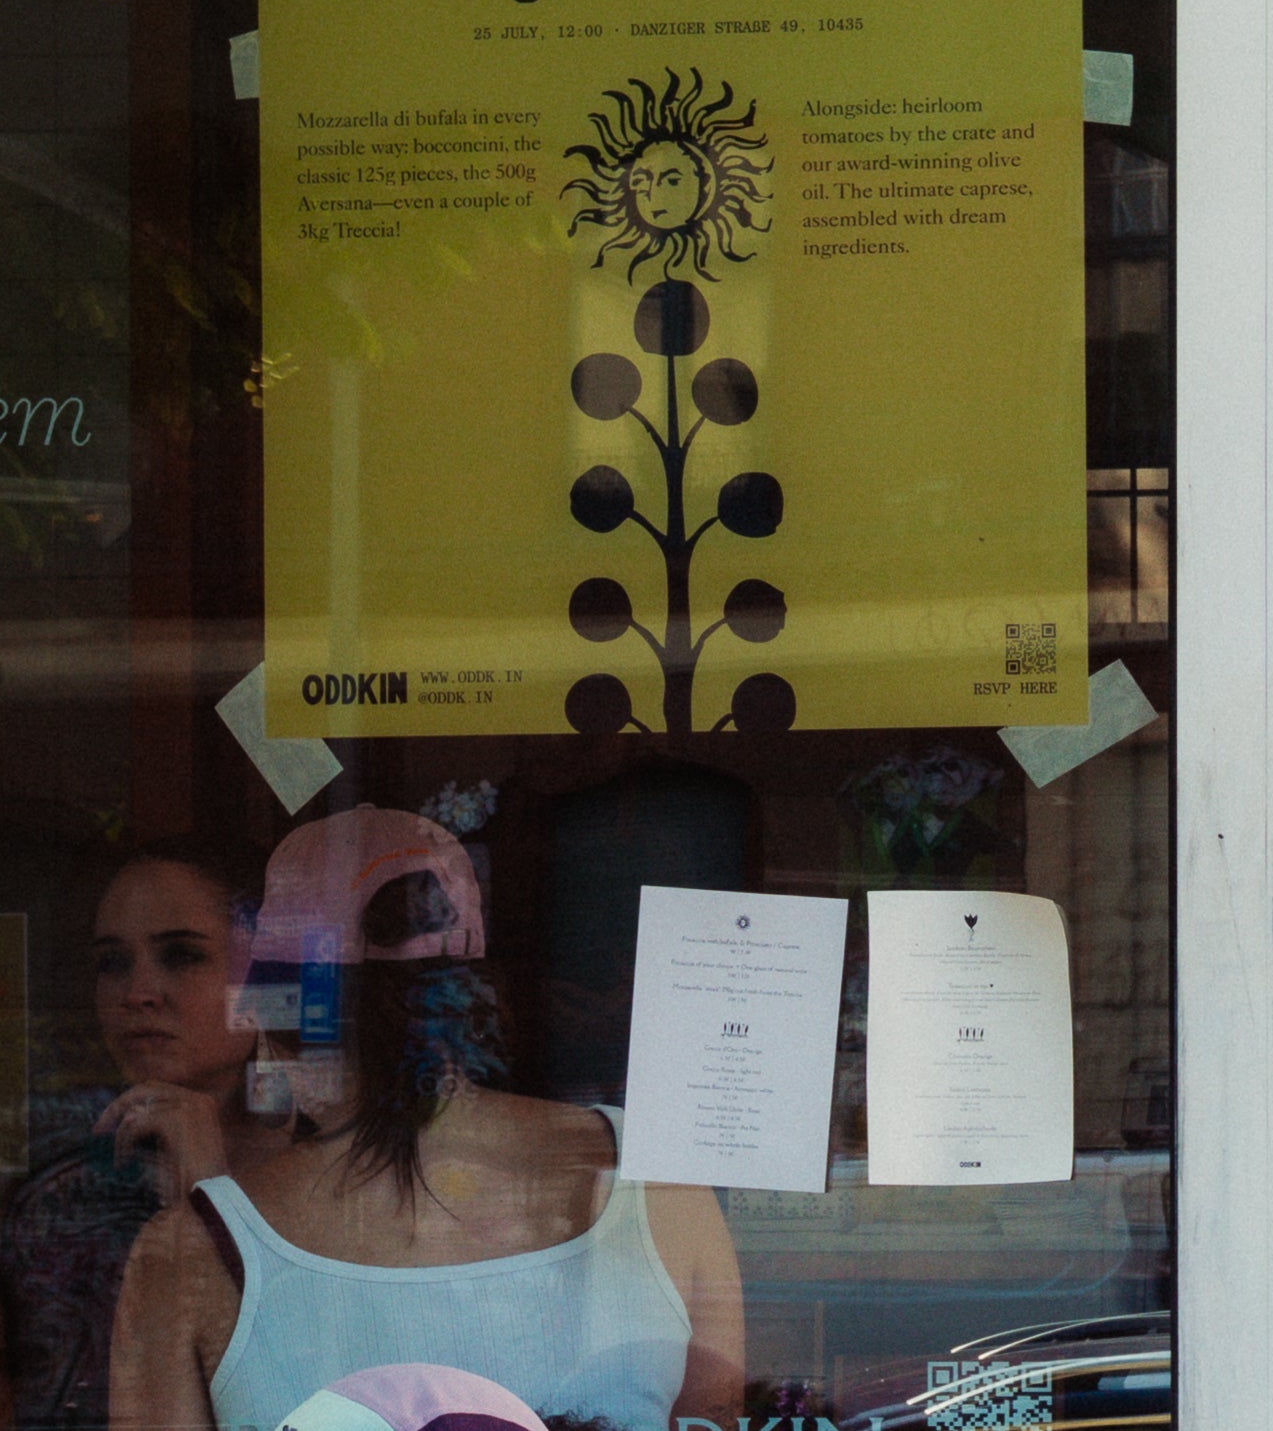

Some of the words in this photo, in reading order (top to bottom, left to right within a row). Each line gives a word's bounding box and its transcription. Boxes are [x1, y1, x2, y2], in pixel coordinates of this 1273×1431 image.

[473, 28, 492, 40] 25
[501, 26, 545, 41] JULY,
[558, 25, 603, 38] 12:00
[630, 23, 705, 36] DANZIGER
[714, 21, 770, 33] STRAßE
[780, 20, 806, 33] 49,
[818, 18, 863, 31] 10435
[801, 99, 896, 118] Alongside:
[902, 97, 983, 115] heirloom
[296, 110, 389, 130] Mozzarella
[393, 109, 410, 128] di
[415, 109, 468, 127] bufala
[472, 109, 489, 126] in
[494, 110, 541, 129] every
[801, 128, 884, 145] tomatoes
[889, 126, 912, 147] by
[917, 126, 948, 143] the
[952, 126, 997, 141] crate
[1001, 123, 1035, 140] and
[296, 139, 366, 159] possible
[413, 137, 510, 155] bocconcini,
[514, 136, 542, 153] the
[801, 159, 832, 173] our
[837, 153, 972, 174] award-winning
[977, 152, 1022, 168] olive
[296, 167, 351, 184] classic
[356, 166, 396, 186] 125g
[400, 166, 459, 186] pieces,
[463, 164, 491, 182] the
[495, 164, 537, 184] 500g
[801, 184, 830, 200] oil.
[833, 182, 873, 200] The
[878, 181, 955, 198] ultimate
[960, 183, 1033, 200] caprese,
[440, 197, 449, 209] a
[453, 193, 510, 212] couple
[515, 191, 534, 207] of
[802, 210, 898, 229] assembled
[903, 209, 944, 226] with
[949, 207, 1007, 225] dream
[297, 221, 330, 243] 3kg
[333, 221, 401, 239] Treccia!
[803, 238, 910, 258] ingredients.
[420, 670, 523, 684] WWW.ODDK.IN
[302, 671, 408, 706] ODDKIN
[417, 691, 493, 704] @ODDK.IN
[973, 682, 1011, 696] RSVP
[1020, 681, 1058, 694] HERE
